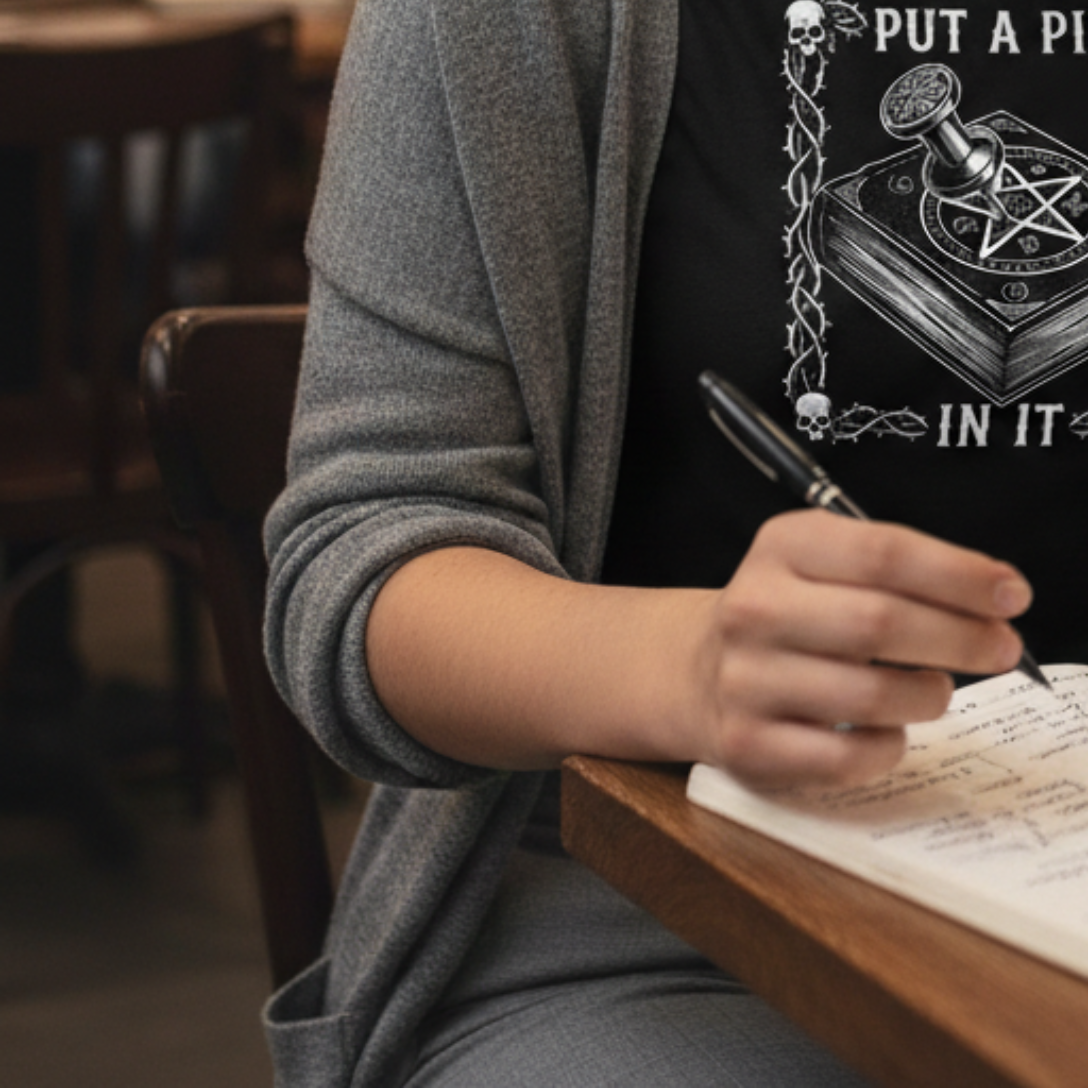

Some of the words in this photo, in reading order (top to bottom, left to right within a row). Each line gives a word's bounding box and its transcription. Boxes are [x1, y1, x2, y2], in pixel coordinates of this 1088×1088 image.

[875, 8, 967, 53] PUT
[989, 10, 1020, 54] A
[937, 403, 990, 447] IN
[1014, 403, 1064, 447] IT
